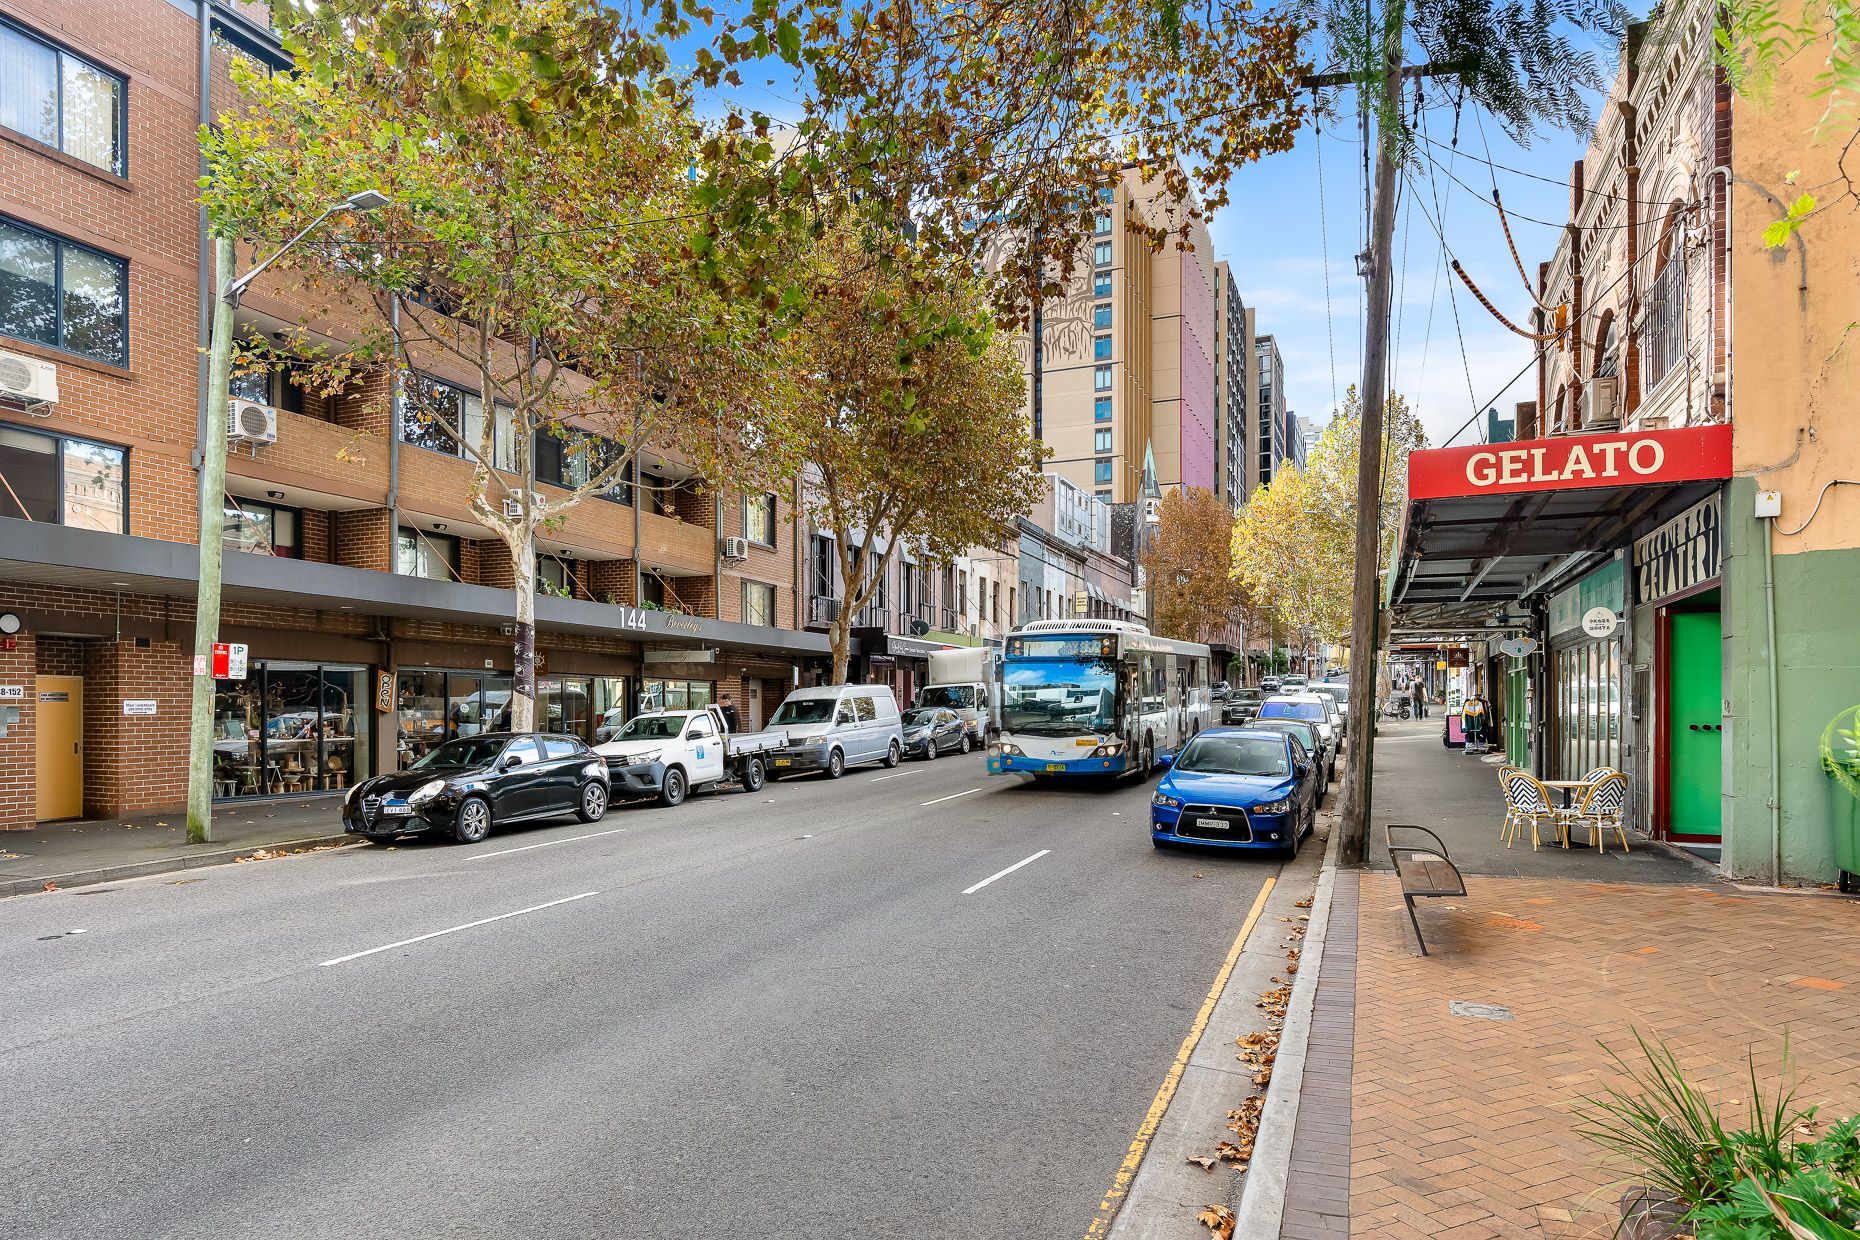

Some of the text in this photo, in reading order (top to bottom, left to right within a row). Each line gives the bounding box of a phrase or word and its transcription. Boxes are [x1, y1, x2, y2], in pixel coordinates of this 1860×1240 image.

[1466, 439, 1665, 487] GELATO
[619, 606, 647, 631] 144
[233, 646, 244, 655] 1P
[0, 688, 22, 696] 8-152
